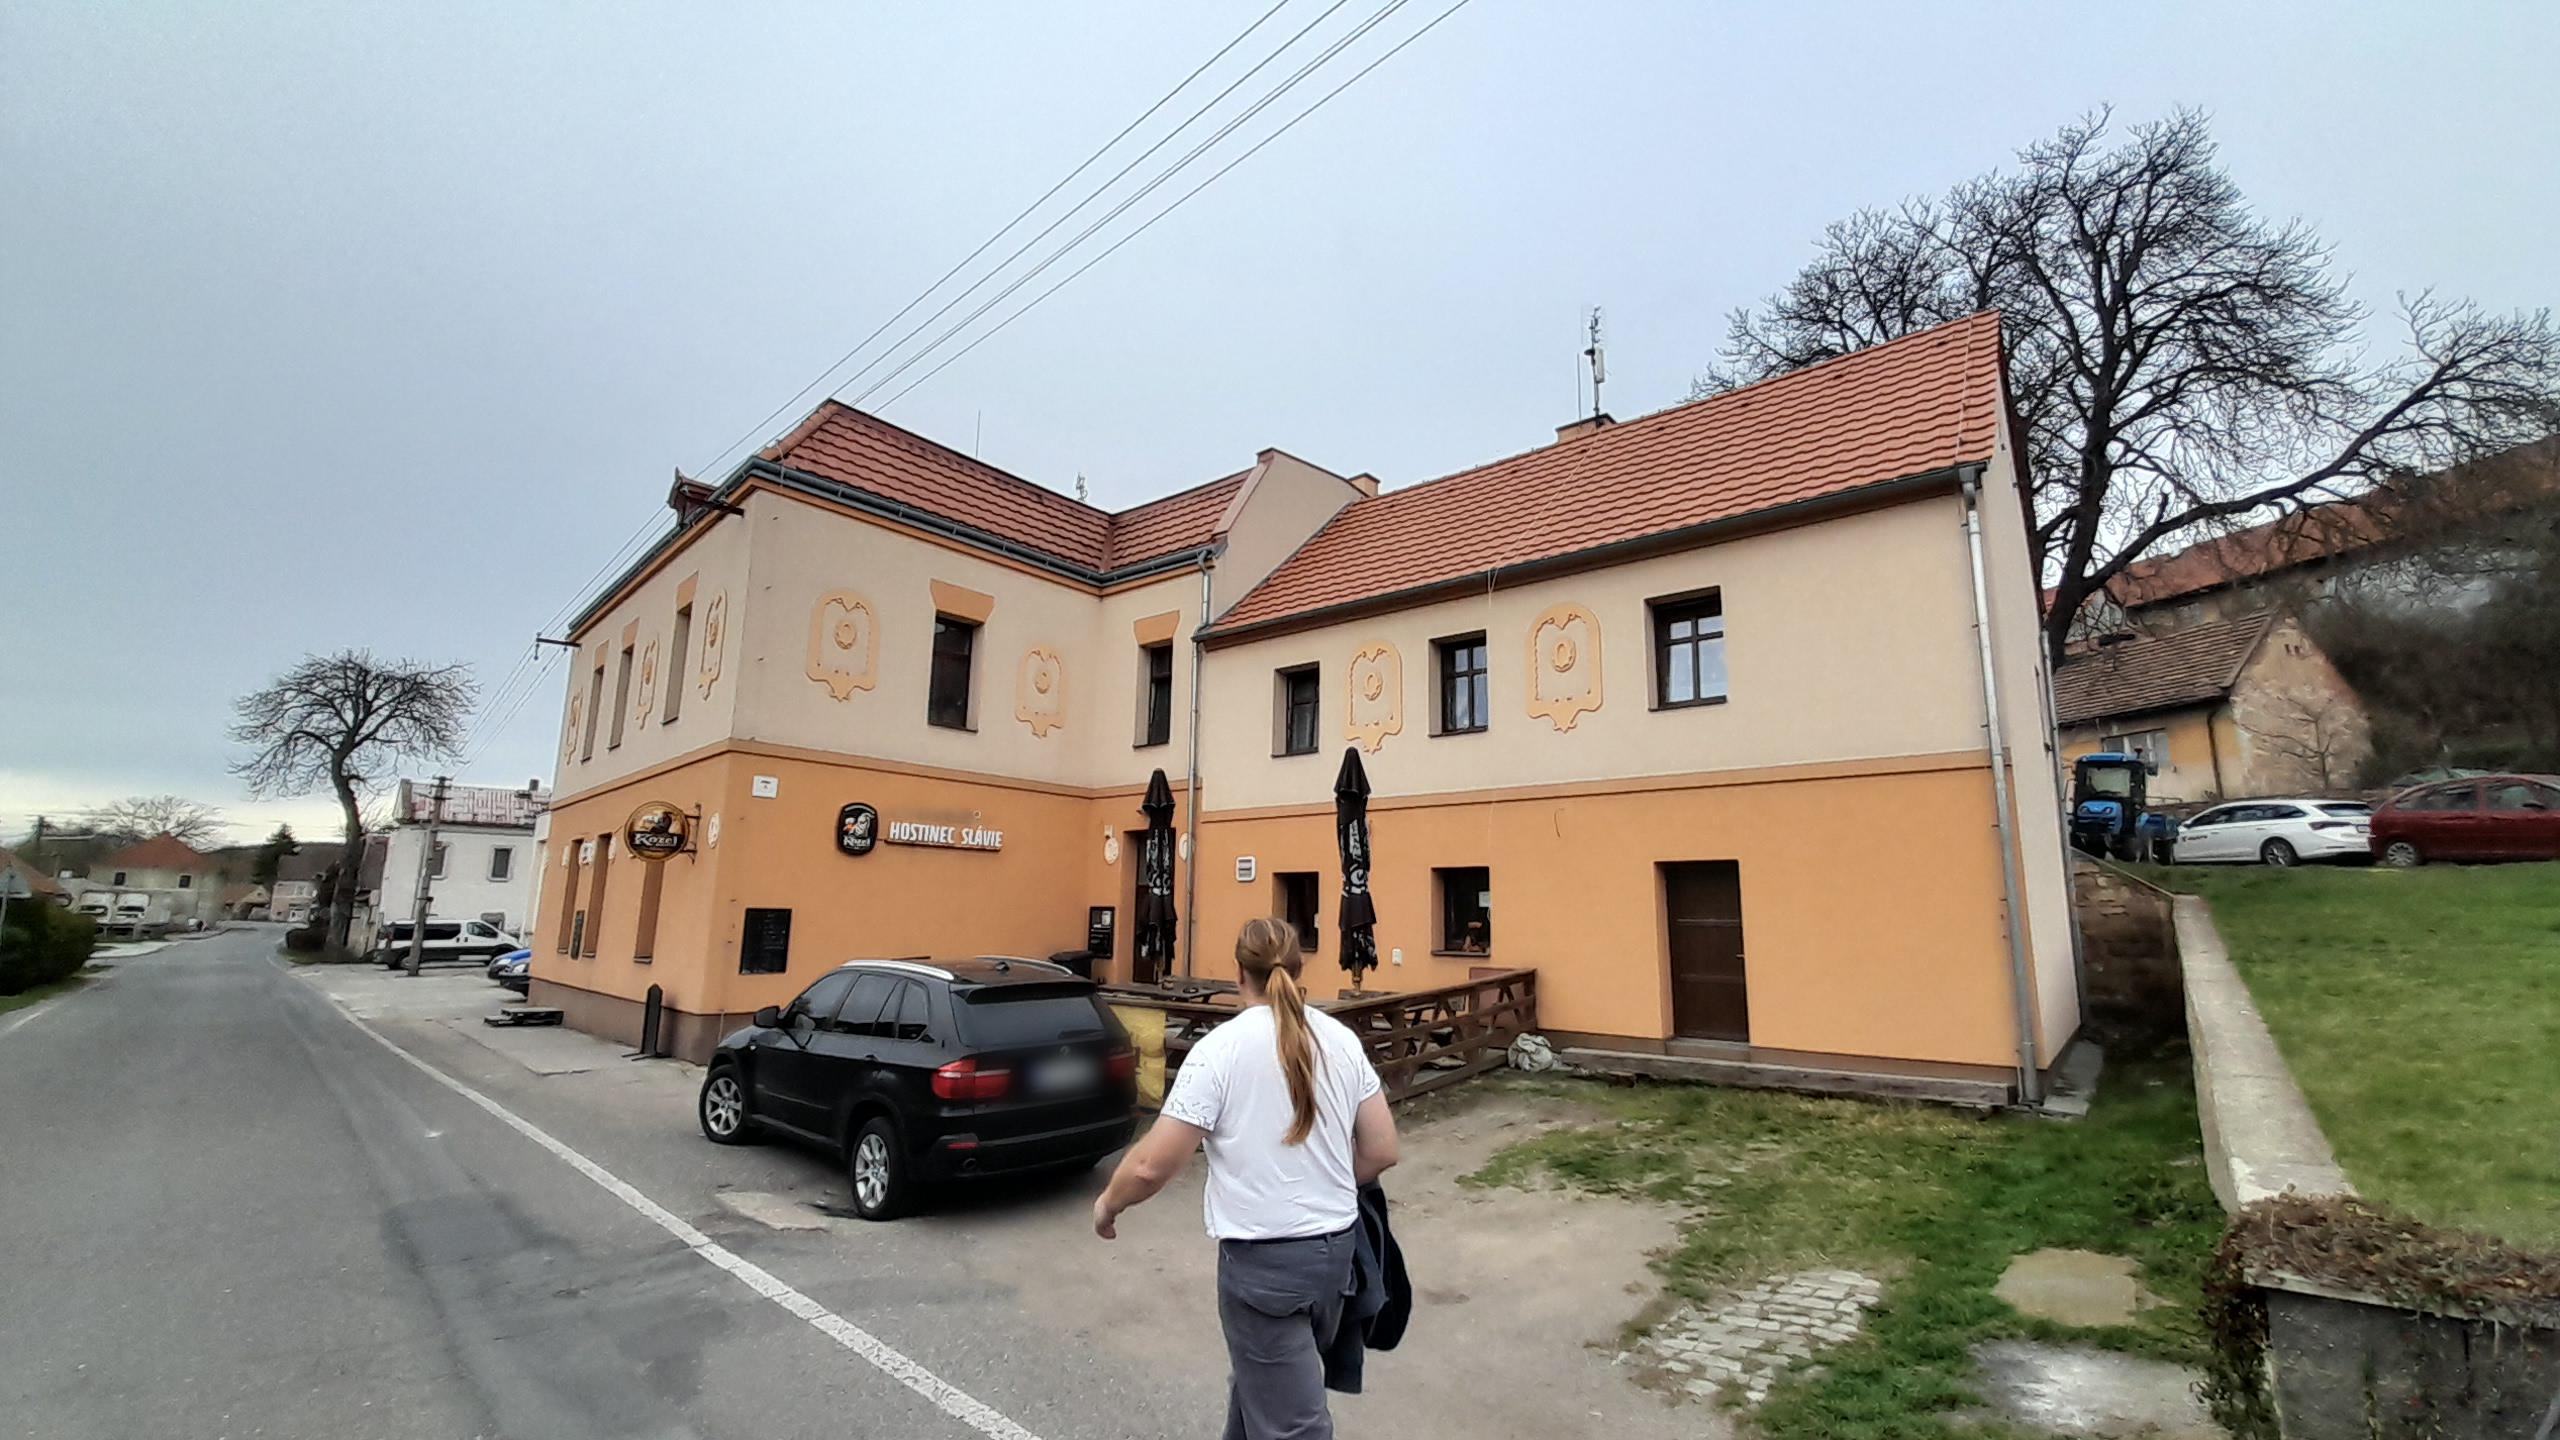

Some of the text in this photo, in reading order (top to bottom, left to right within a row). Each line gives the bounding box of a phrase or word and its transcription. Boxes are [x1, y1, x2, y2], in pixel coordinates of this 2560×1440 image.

[634, 833, 678, 847] Kozel
[843, 835, 871, 847] Kozel
[889, 821, 1003, 847] HOSTINEC SLÁVIE
